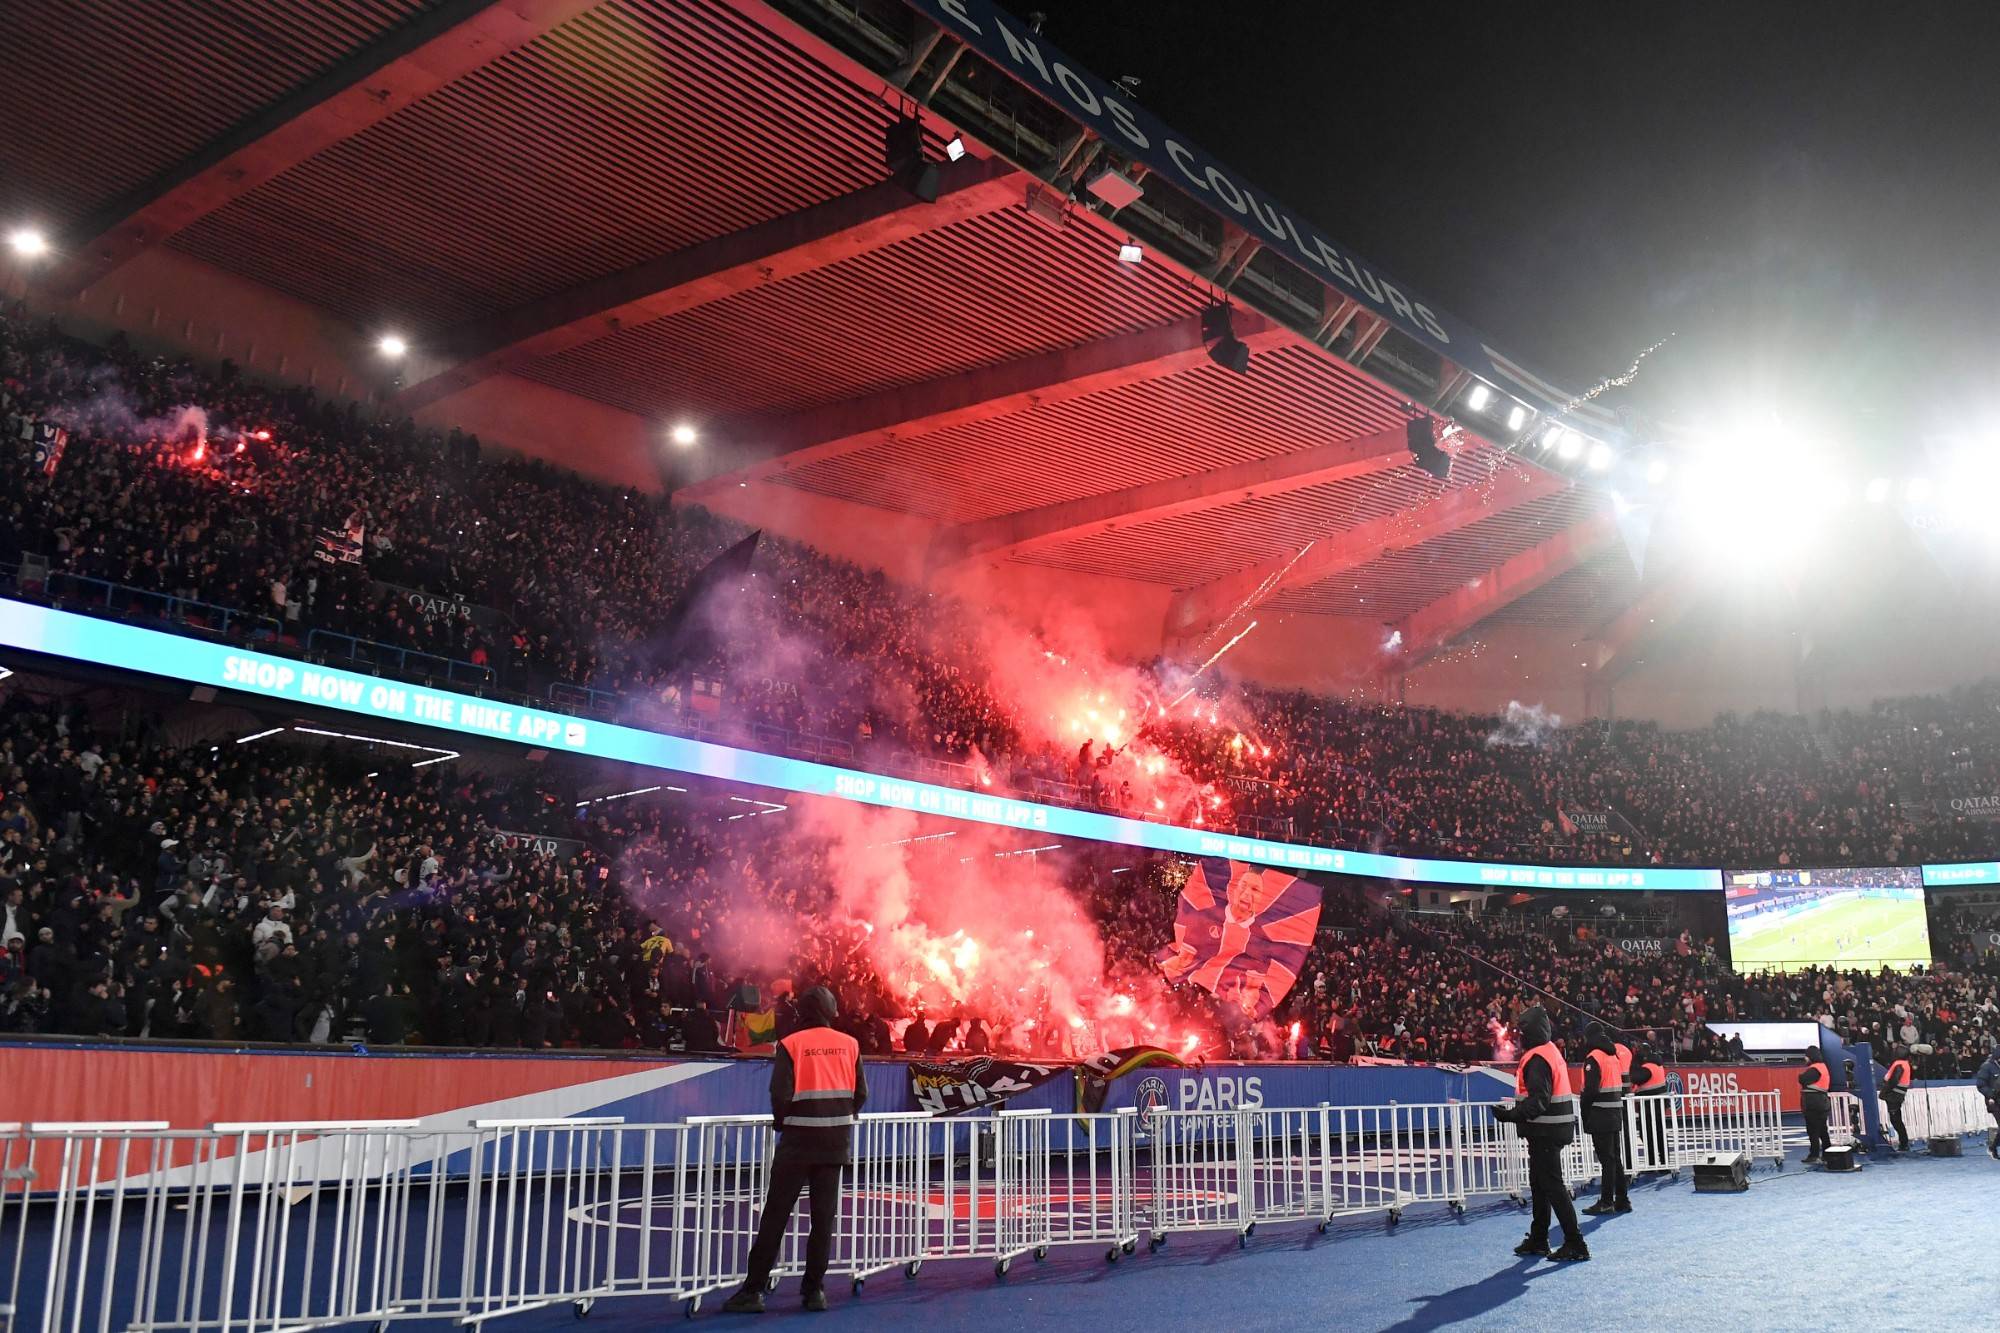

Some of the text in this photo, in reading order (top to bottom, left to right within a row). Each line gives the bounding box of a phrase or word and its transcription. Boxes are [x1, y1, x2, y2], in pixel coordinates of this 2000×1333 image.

[994, 16, 1151, 149] NOS
[1165, 139, 1450, 343] COULEURS
[223, 655, 561, 741] SHOP NOW ON THE NIKE APP
[835, 774, 875, 797] SHOP
[880, 782, 914, 804] NOW
[920, 788, 940, 809] ON
[943, 793, 968, 815] THE
[1951, 796, 2000, 811] QATAR
[1570, 813, 1608, 826] QATAR
[1621, 939, 1662, 953] QATAR
[1140, 1079, 1165, 1094] PARIS
[1180, 1077, 1263, 1111] PARIS
[1687, 1073, 1739, 1095] PARIS
